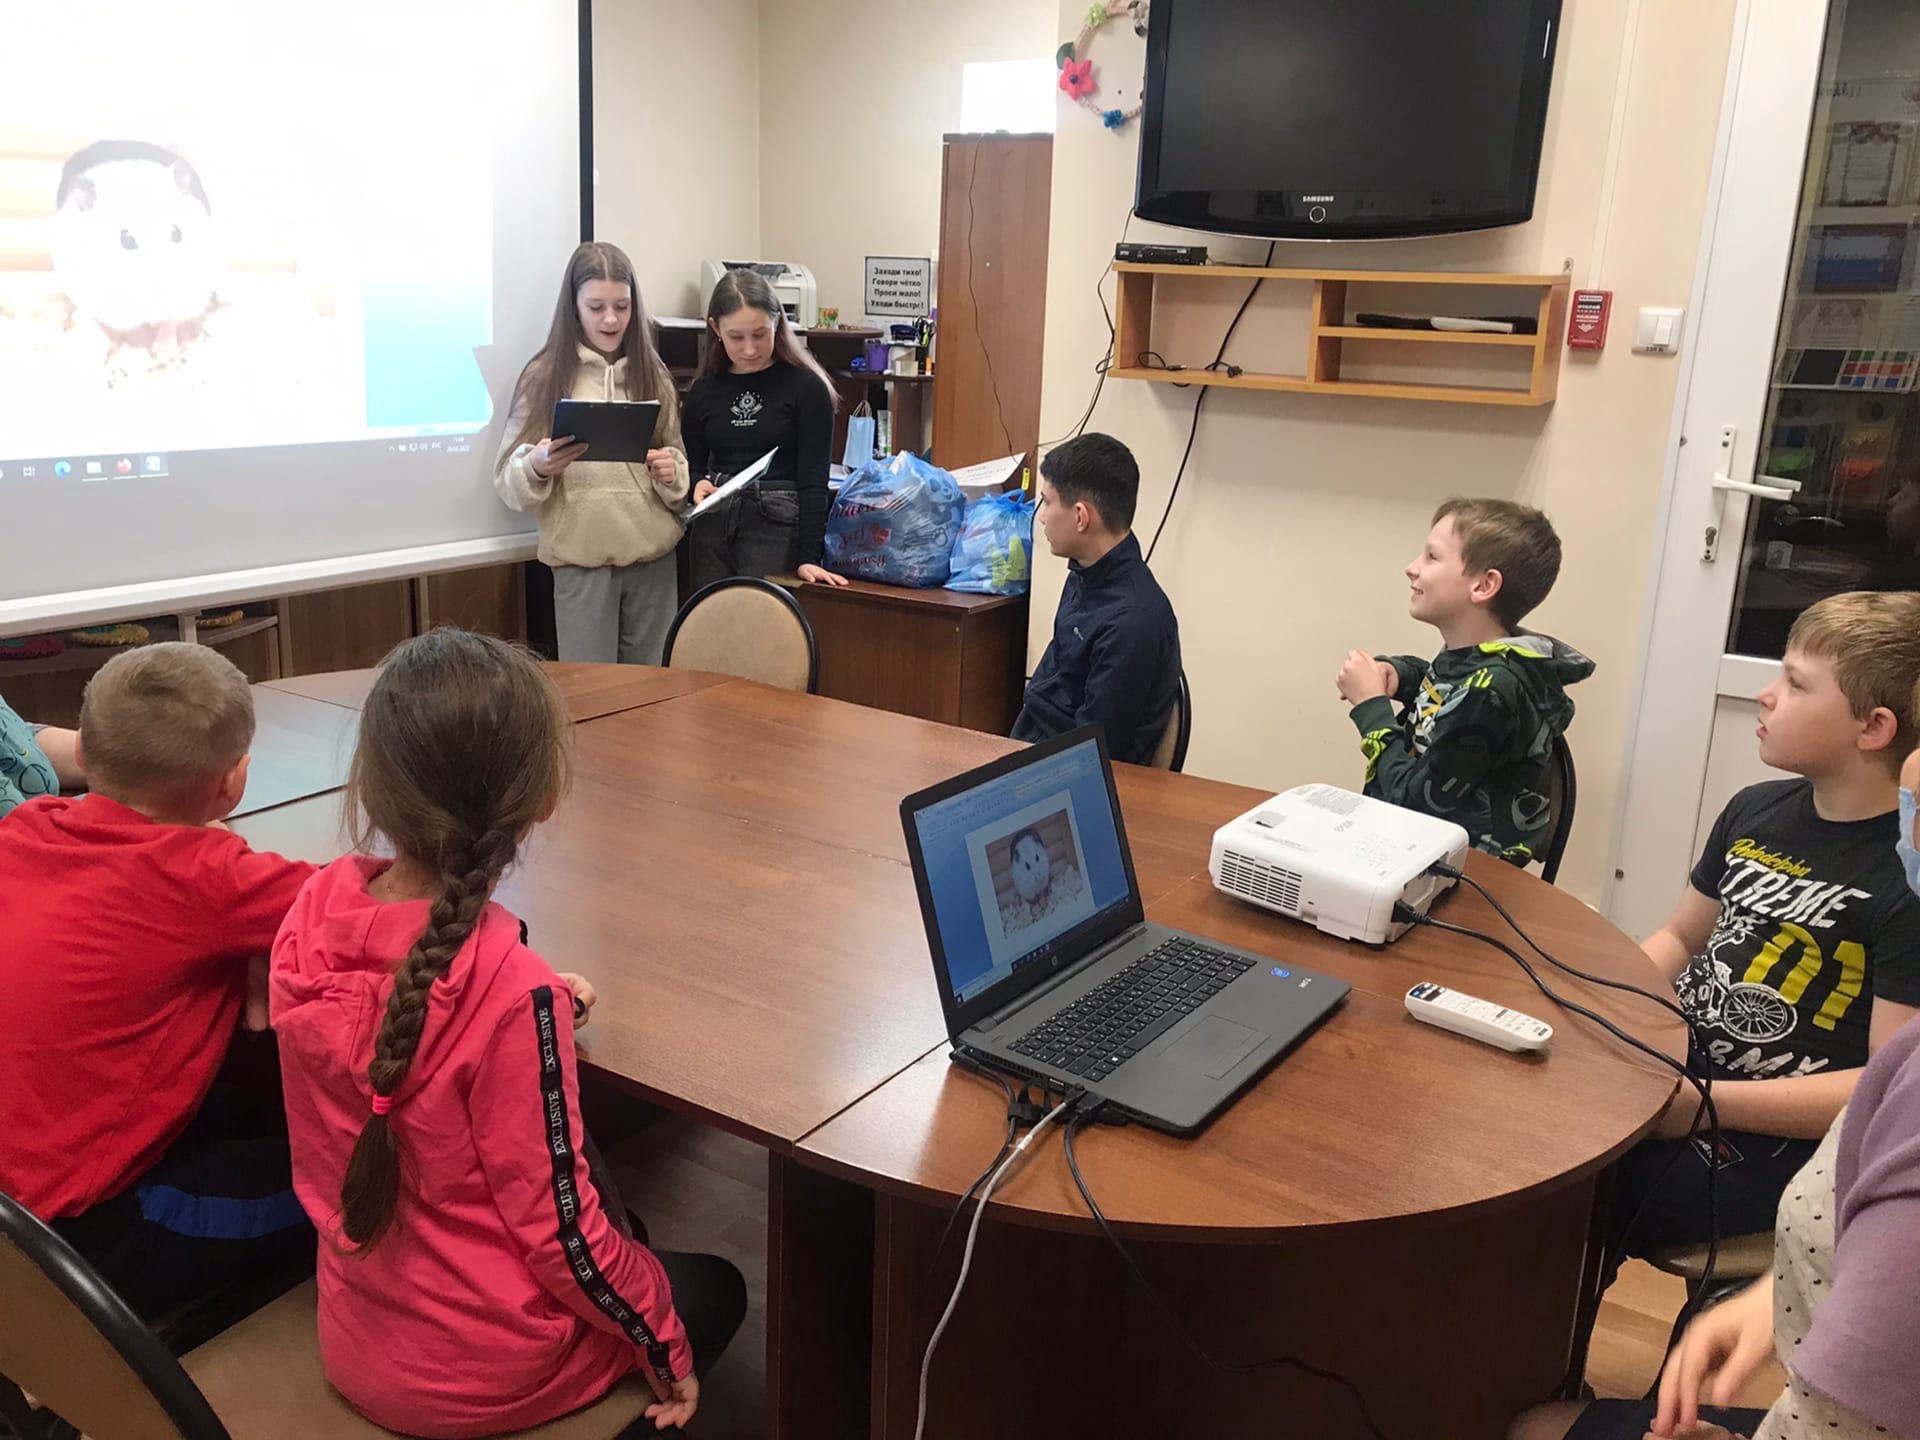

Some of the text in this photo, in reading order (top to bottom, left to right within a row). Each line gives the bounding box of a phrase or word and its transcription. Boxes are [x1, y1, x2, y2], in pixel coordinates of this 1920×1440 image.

[874, 267, 901, 275] Заходи
[872, 278, 898, 287] Говори
[874, 289, 897, 297] Проси
[871, 299, 893, 308] Уходи
[539, 1007, 557, 1073] EXCLUSIVE
[548, 1090, 568, 1155] EXCLUSIVE
